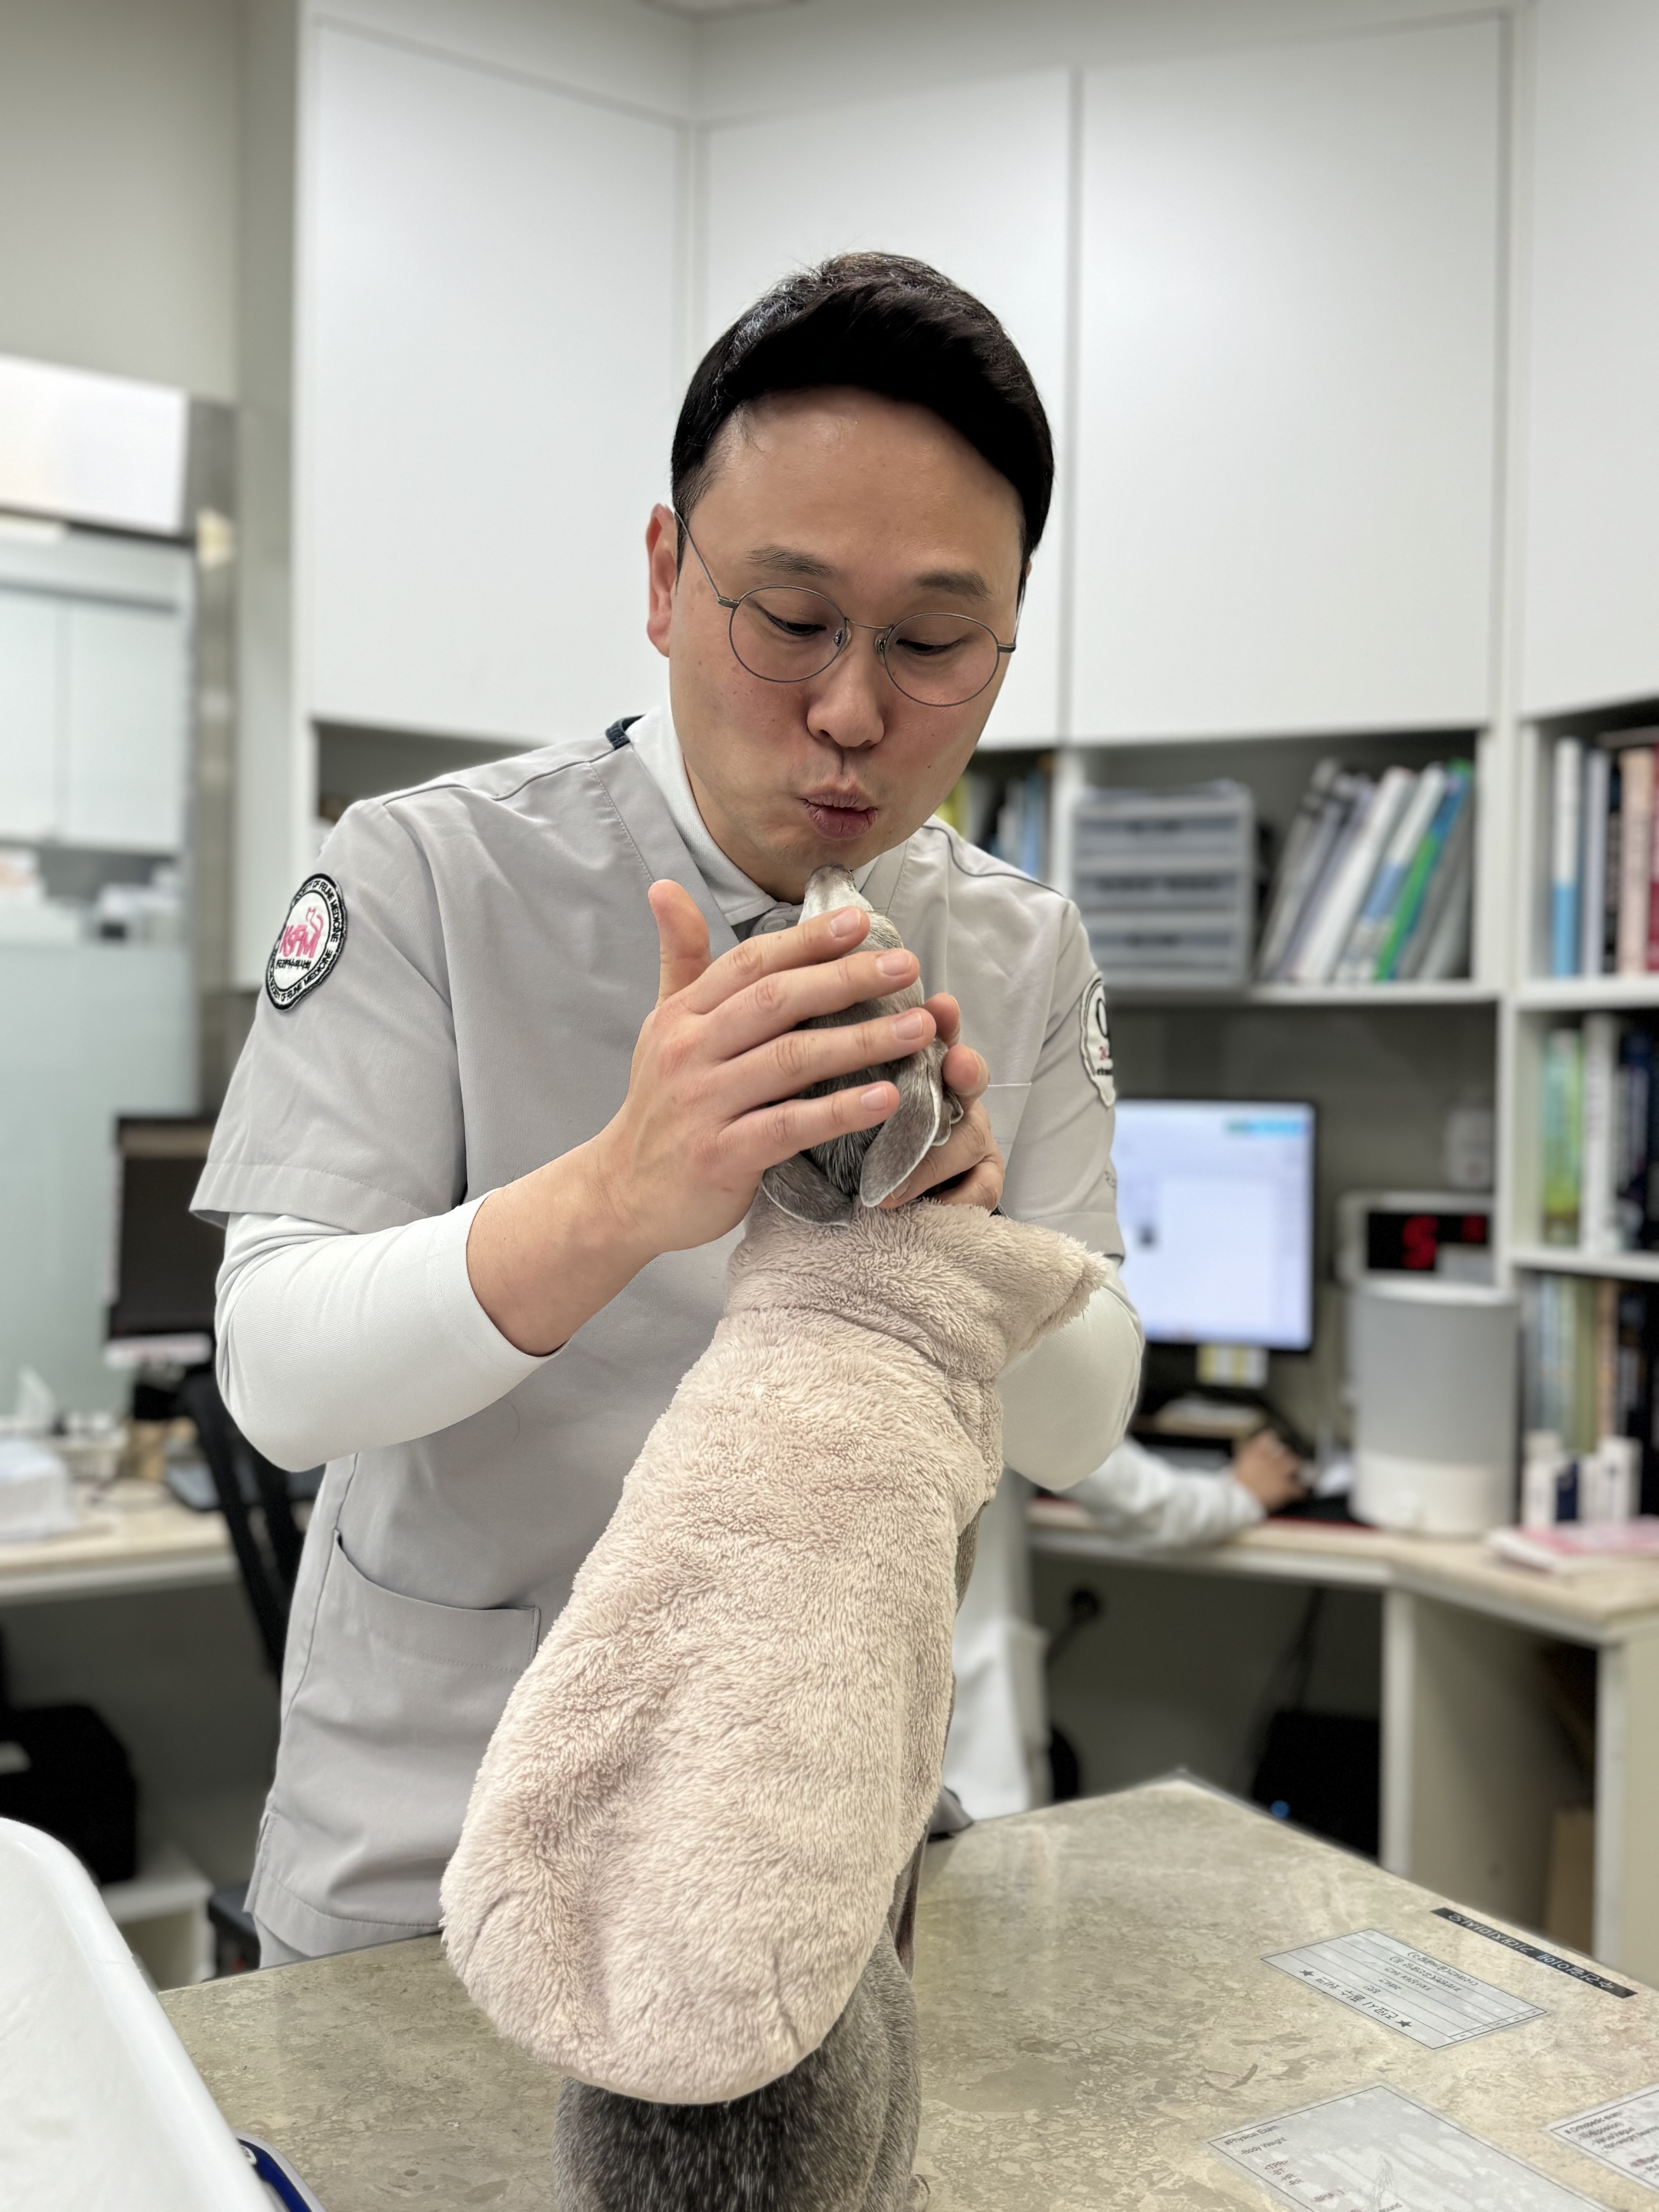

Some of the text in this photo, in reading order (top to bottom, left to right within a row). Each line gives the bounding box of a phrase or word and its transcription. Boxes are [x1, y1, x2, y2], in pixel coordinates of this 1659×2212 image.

[330, 898, 342, 943] MEDICINE
[304, 949, 333, 986] MEDICINE
[1448, 1913, 1614, 1989] 수건걸이에 기대지마시오
[1316, 1976, 1399, 2020] 진료시 필수 체크
